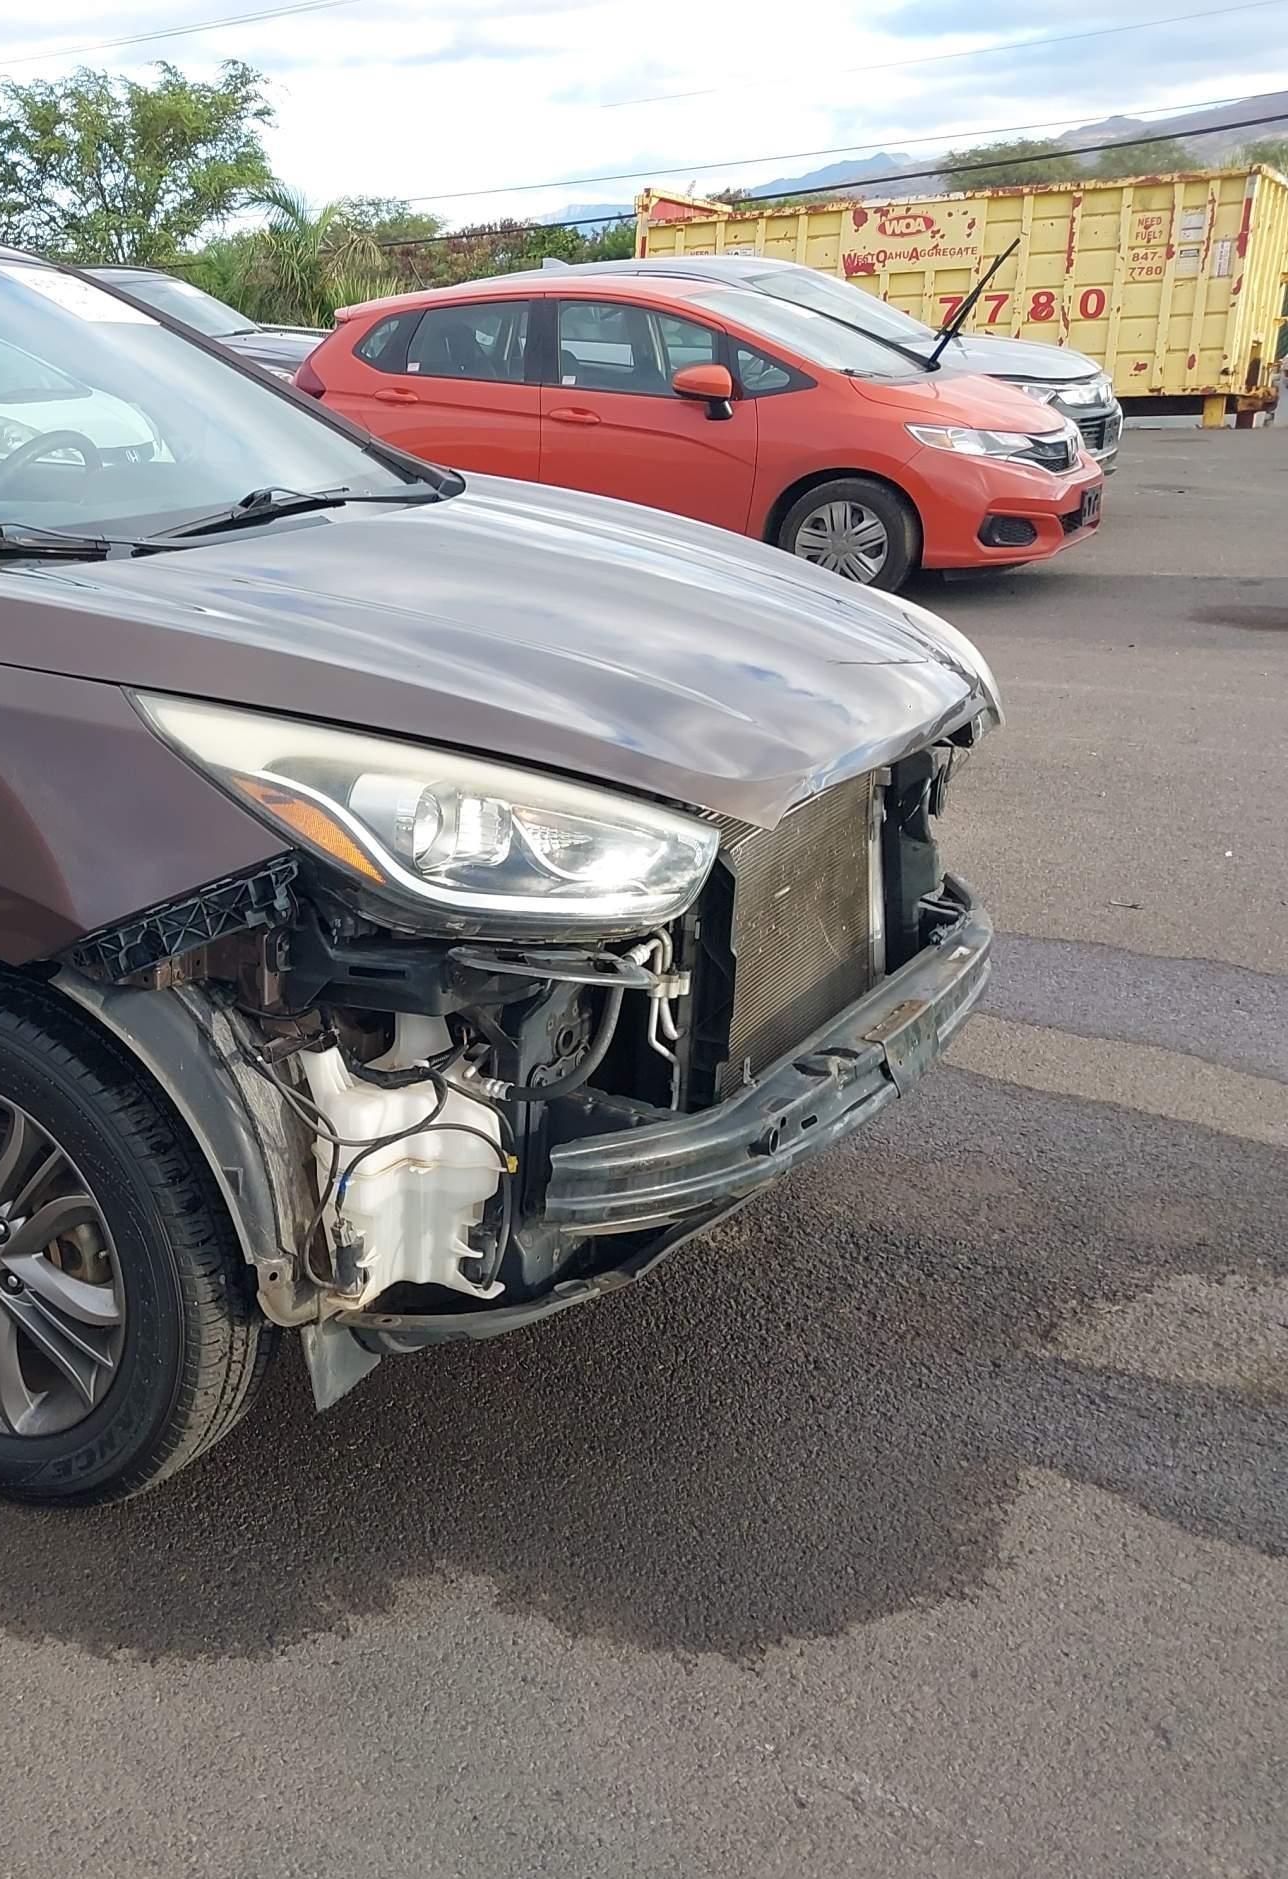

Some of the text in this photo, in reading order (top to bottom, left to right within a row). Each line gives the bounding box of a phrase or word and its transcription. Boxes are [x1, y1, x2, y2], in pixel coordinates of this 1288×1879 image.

[884, 217, 927, 235] WOA
[1137, 216, 1163, 228] NEED
[1135, 230, 1163, 241] FUEL?
[1127, 265, 1163, 277] 7780
